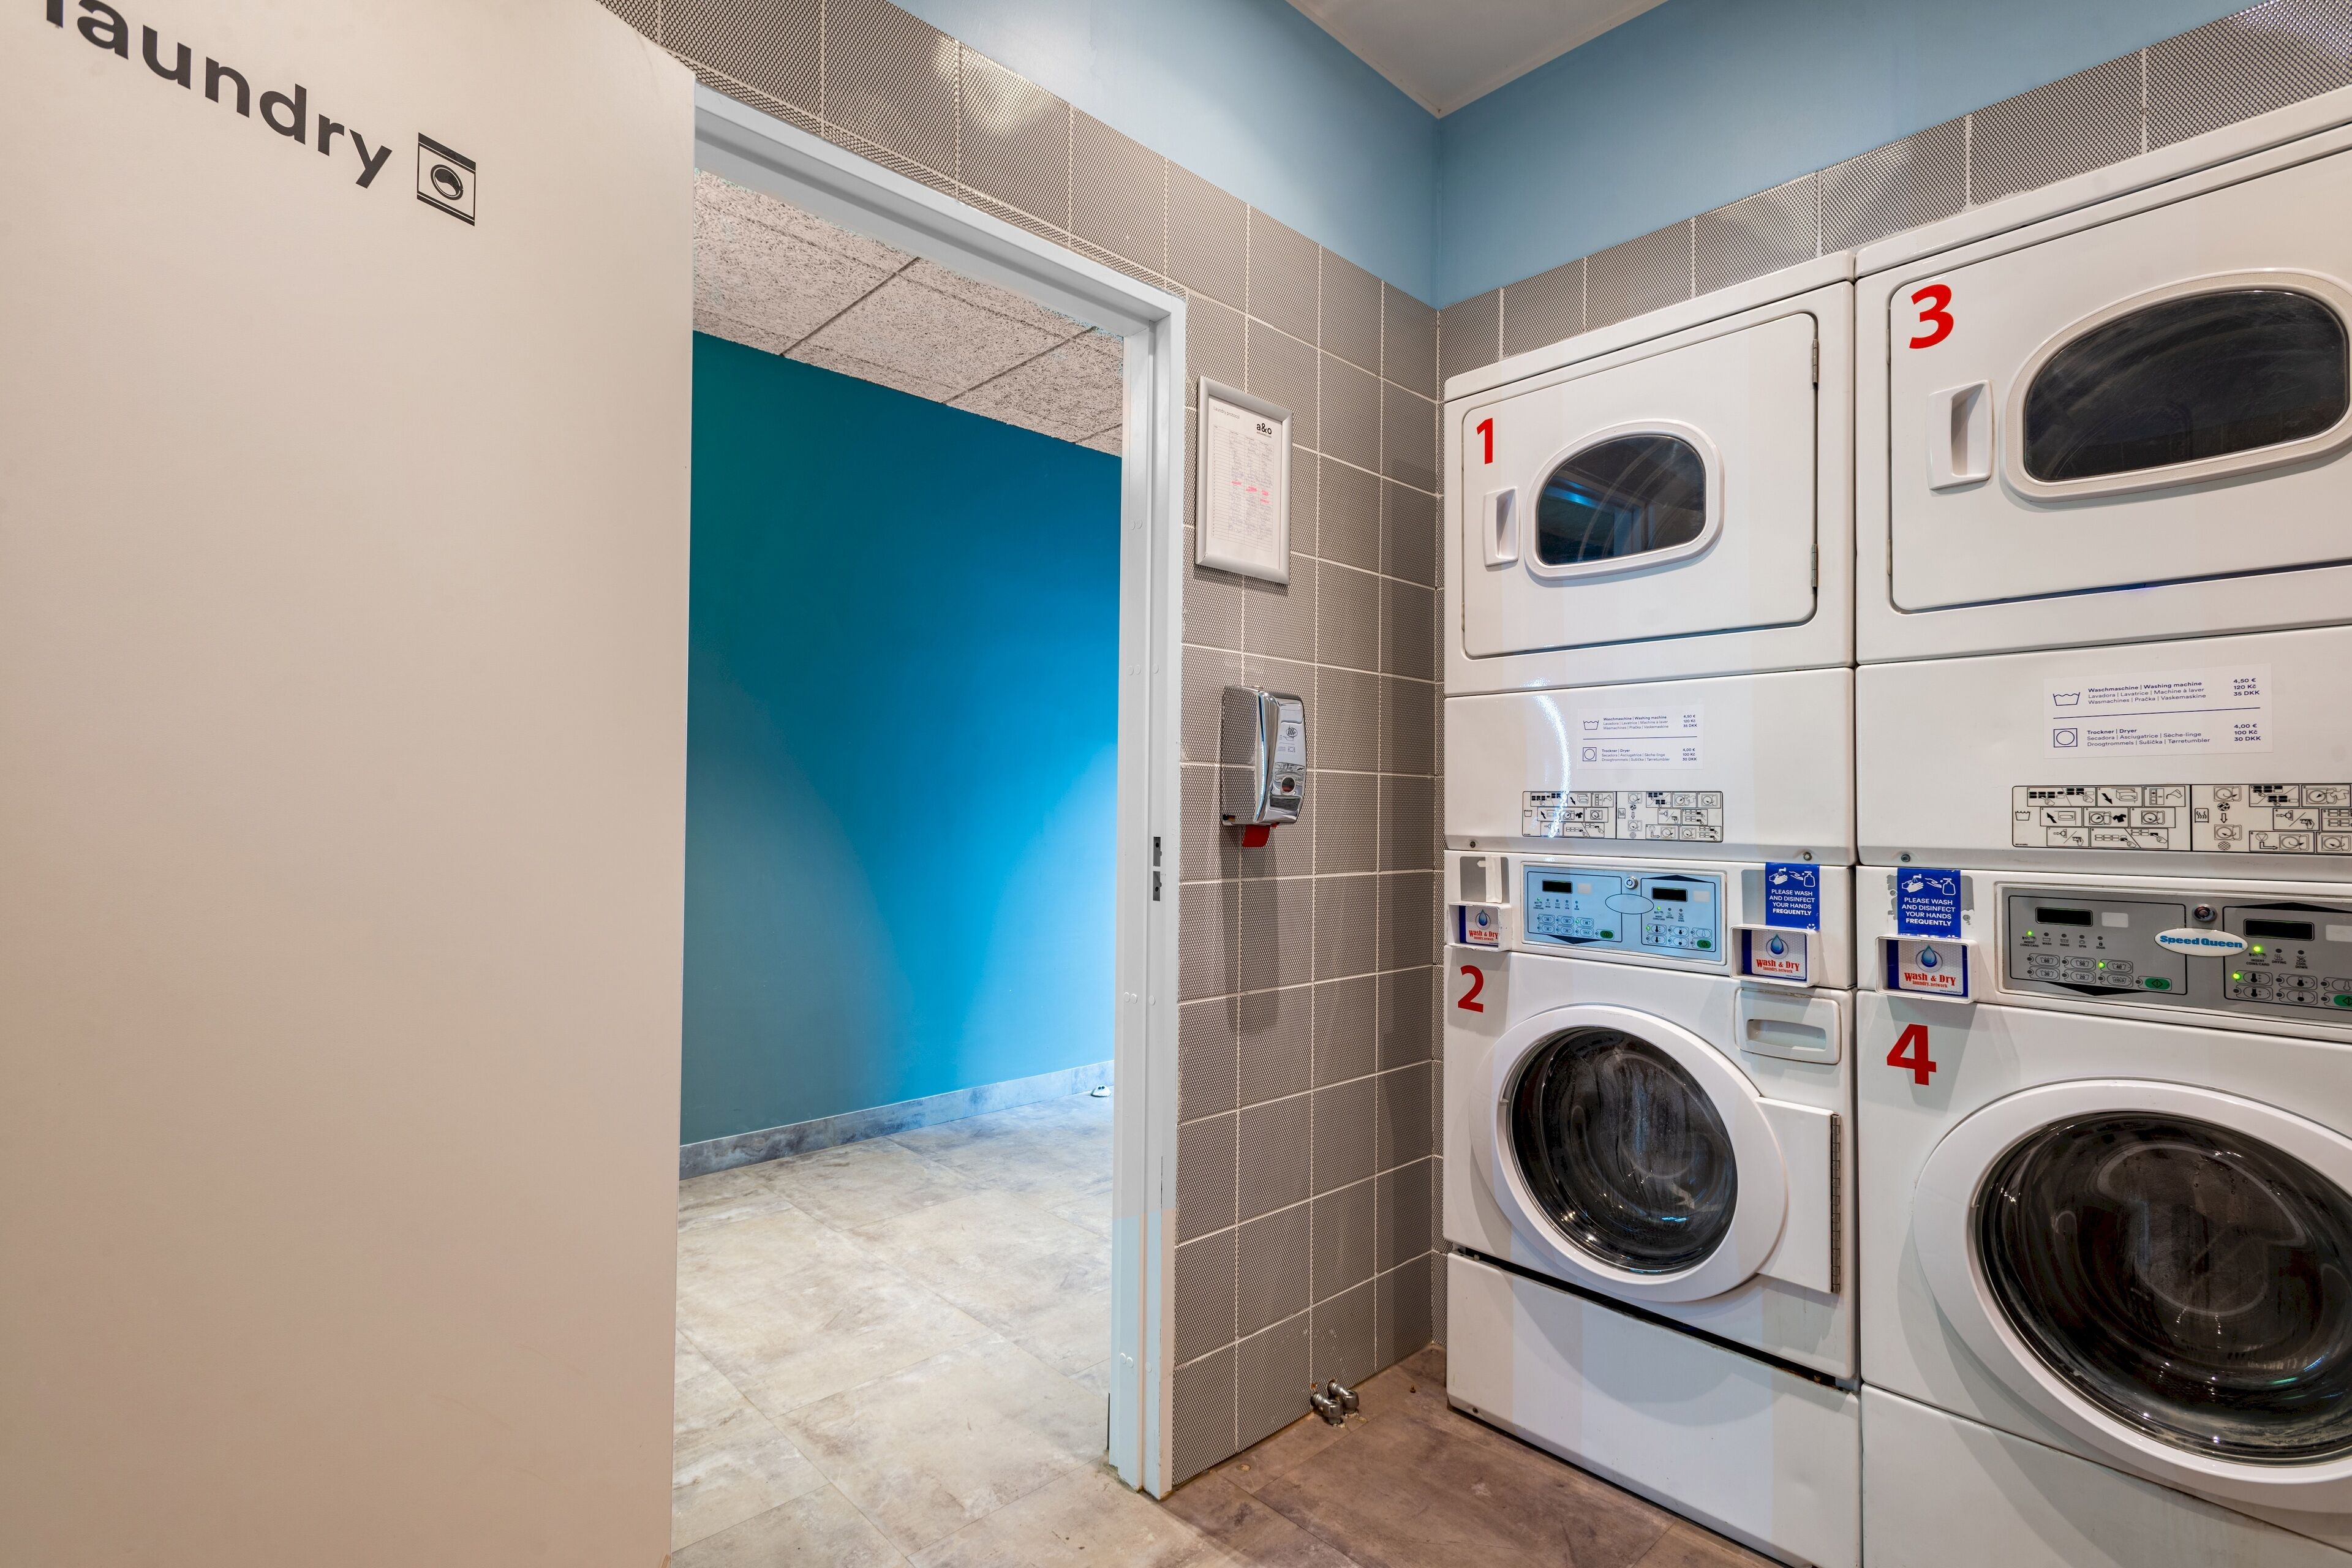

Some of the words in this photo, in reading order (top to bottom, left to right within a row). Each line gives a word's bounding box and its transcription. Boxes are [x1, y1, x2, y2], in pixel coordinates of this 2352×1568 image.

[1909, 284, 1954, 349] 3
[1257, 423, 1272, 434] a&o
[1477, 418, 1493, 464] 1
[2160, 935, 2199, 944] Speed
[2201, 938, 2242, 948] Queen
[1756, 959, 1776, 968] Wash
[1786, 961, 1800, 971] Dry
[1904, 973, 1928, 981] Wash
[1939, 975, 1956, 986] Dry
[1458, 965, 1483, 1012] 2
[1887, 1024, 1936, 1085] 4
